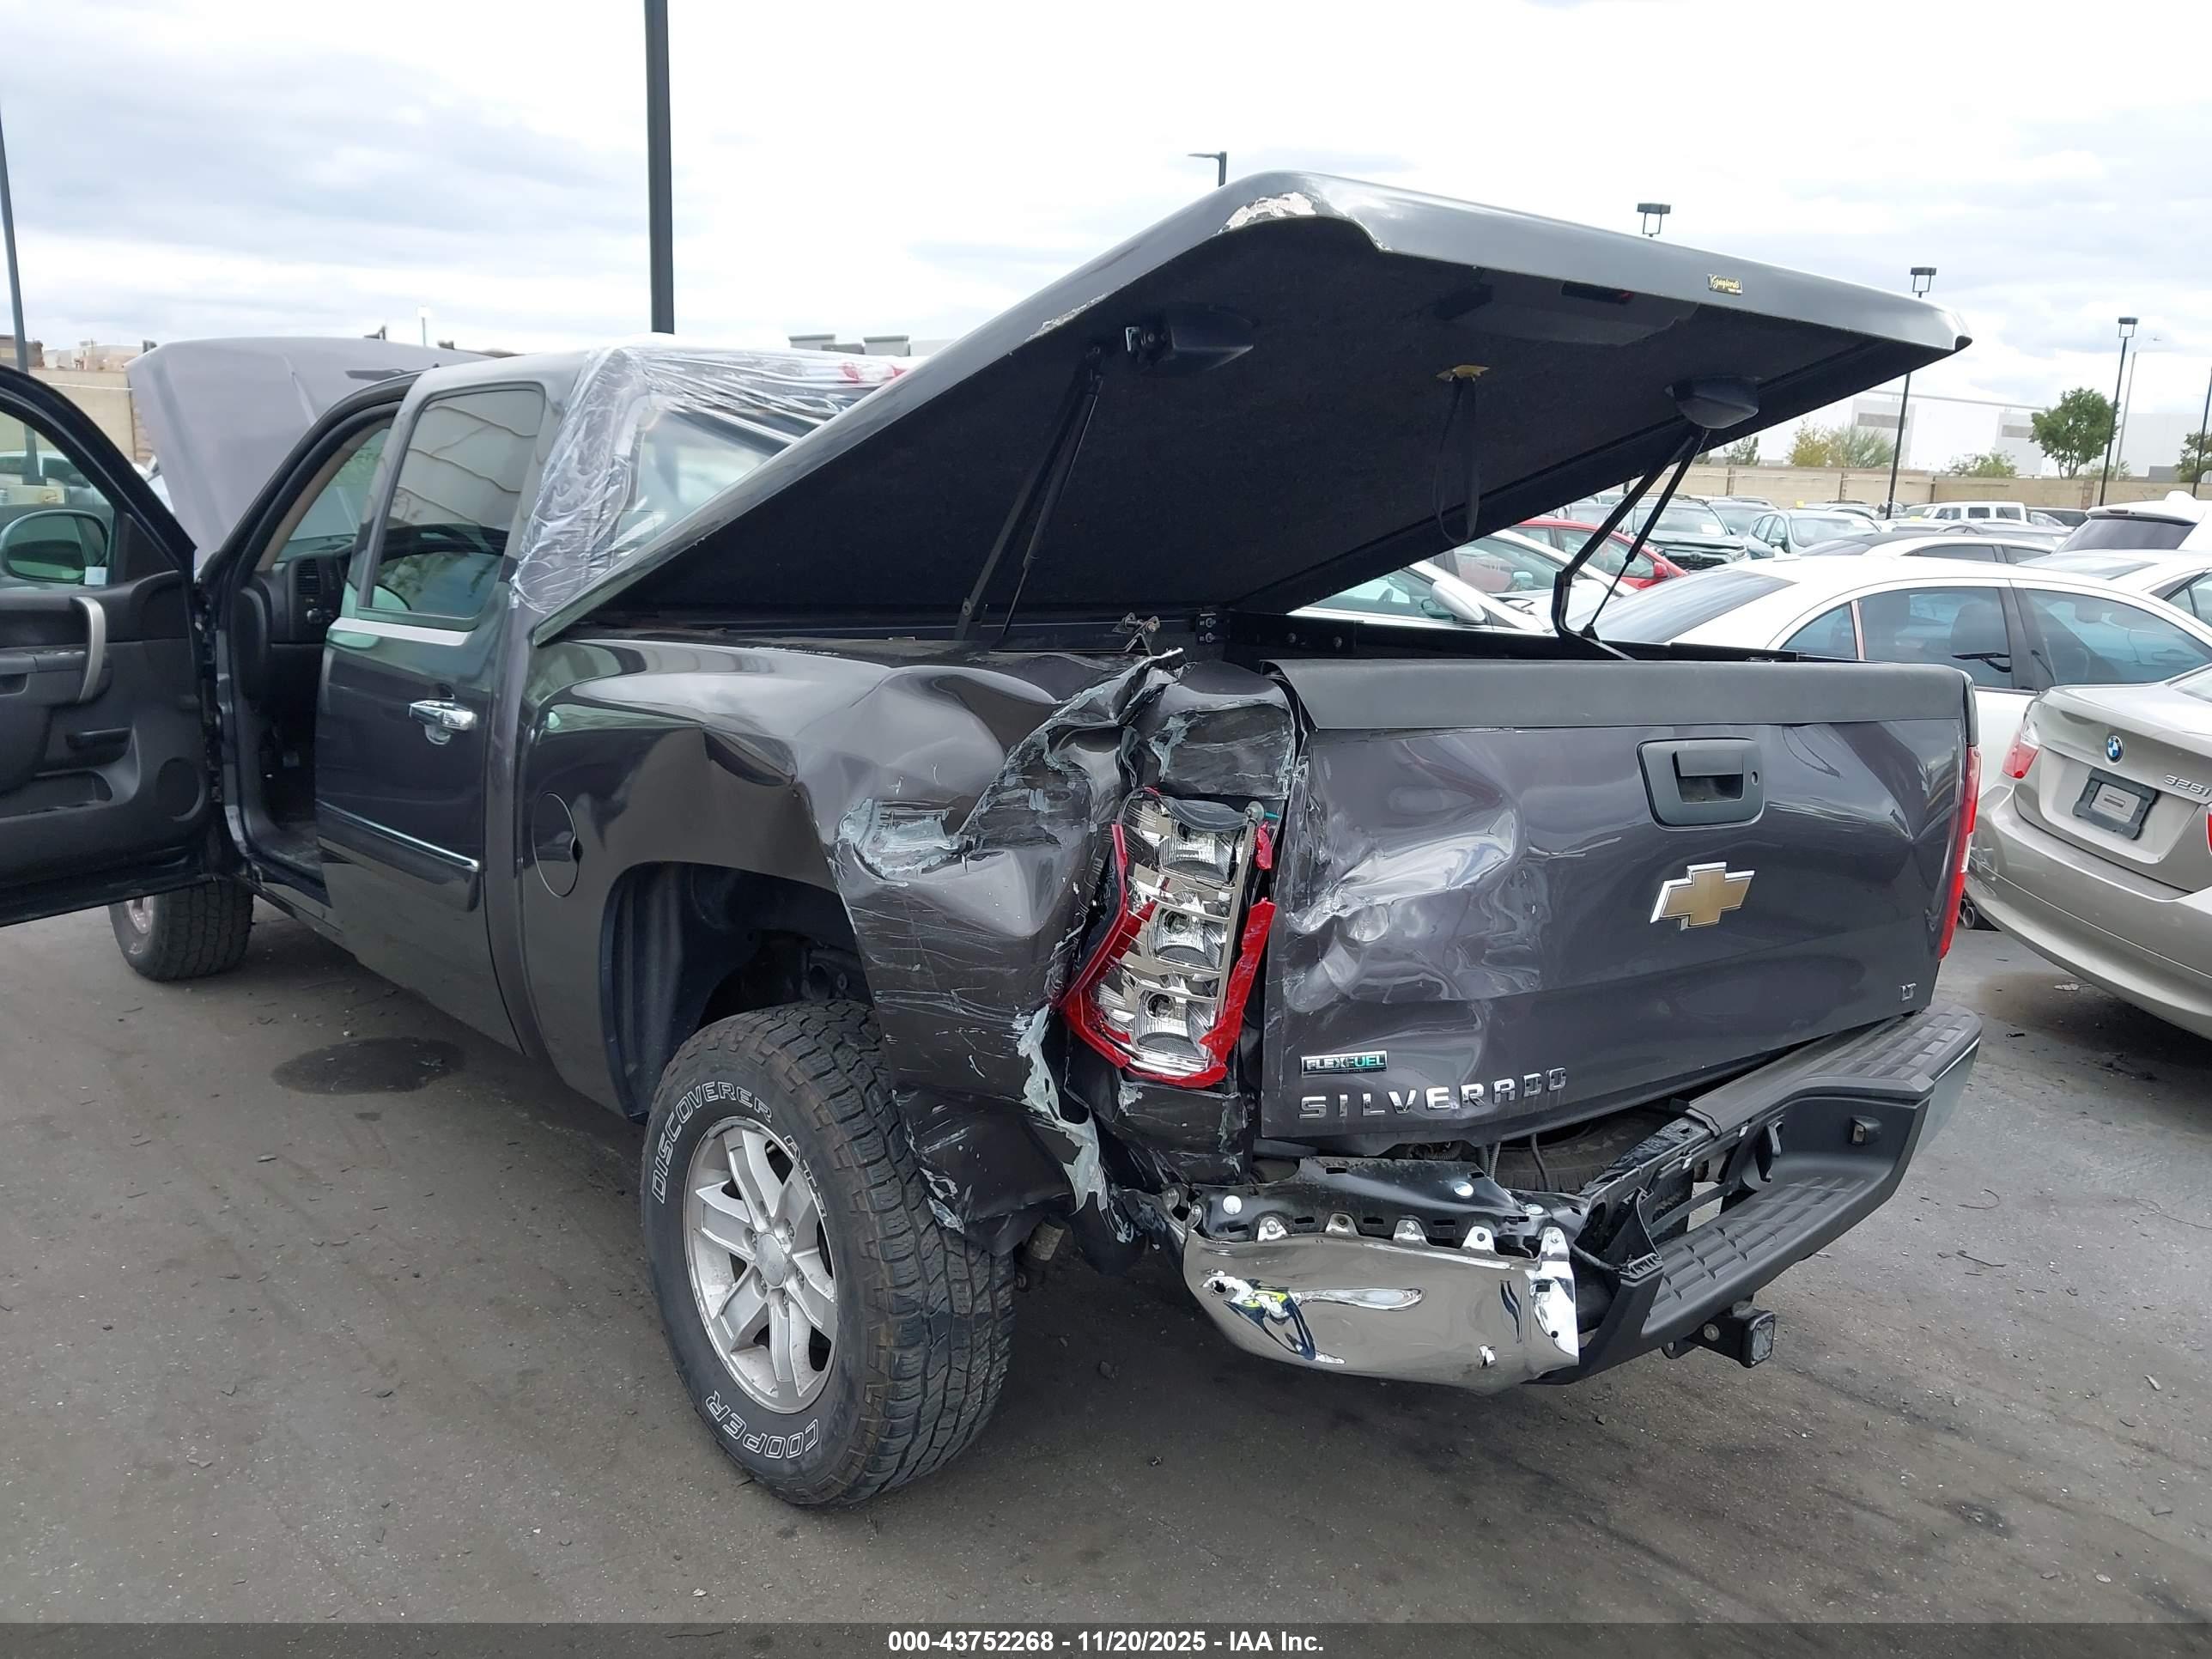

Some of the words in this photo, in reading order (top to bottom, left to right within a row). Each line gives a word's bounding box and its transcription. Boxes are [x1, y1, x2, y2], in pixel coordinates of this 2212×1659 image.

[2163, 774, 2211, 797] 328i
[1306, 1054, 1385, 1071] FLEXFUEL
[1298, 1067, 1567, 1119] SILVERADO
[651, 1080, 773, 1205] DISCOVERER
[704, 1389, 819, 1460] COOPER
